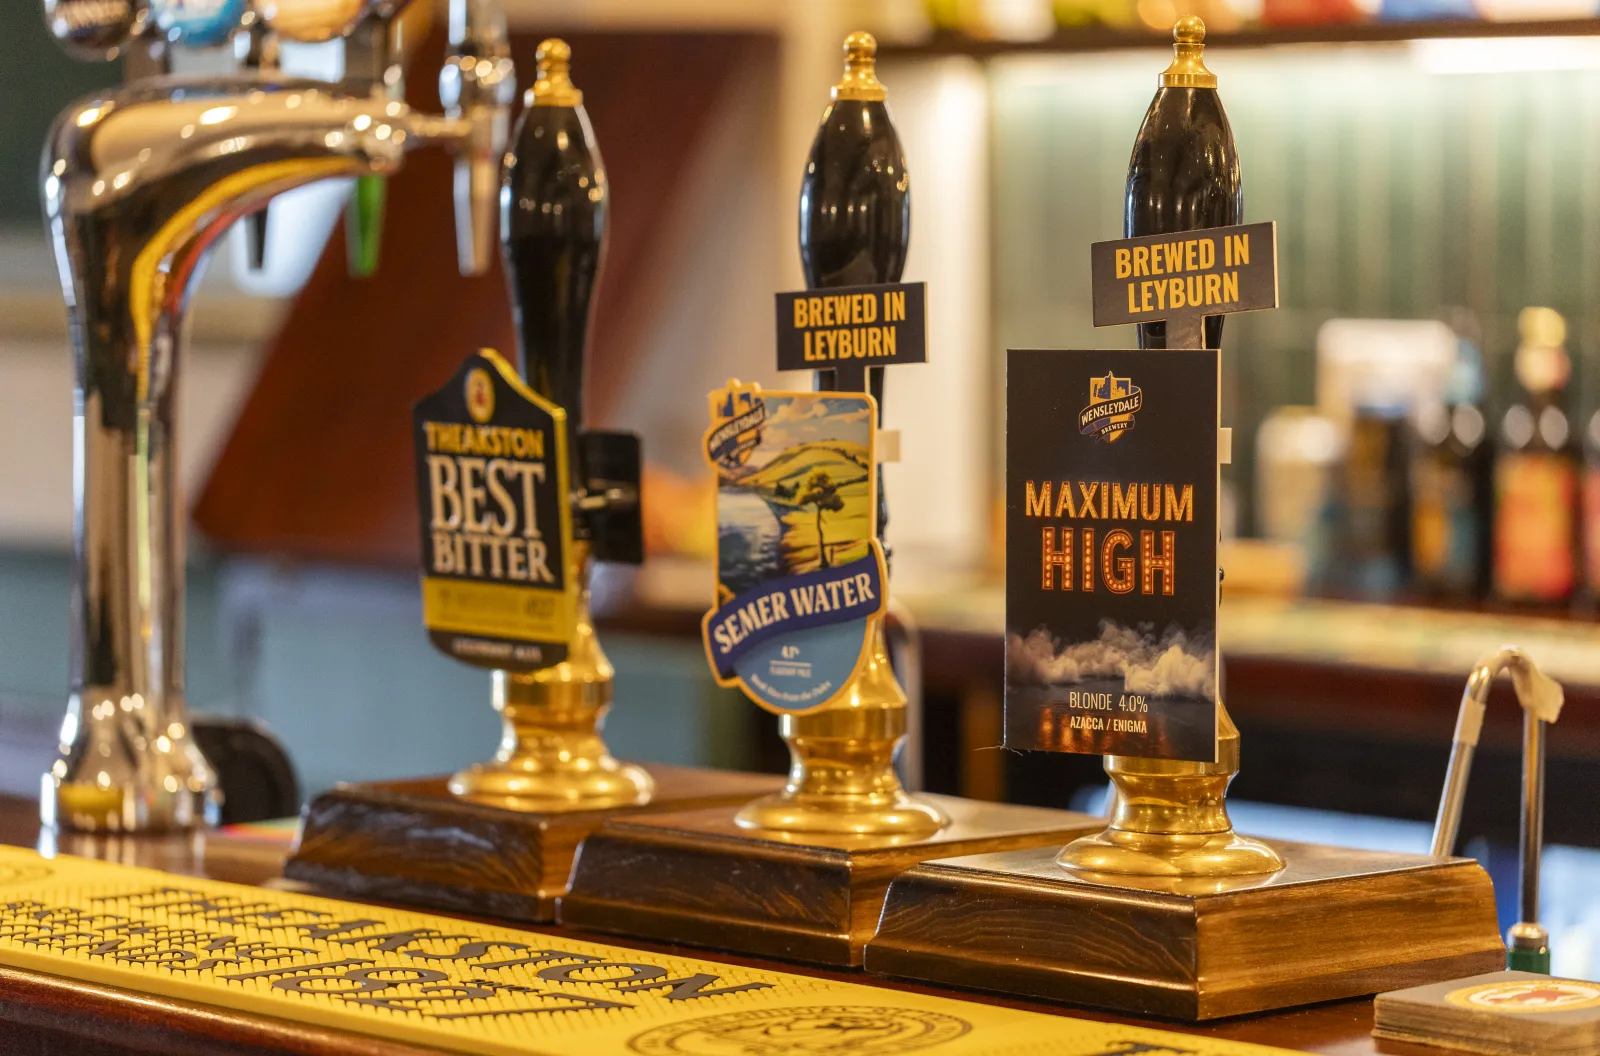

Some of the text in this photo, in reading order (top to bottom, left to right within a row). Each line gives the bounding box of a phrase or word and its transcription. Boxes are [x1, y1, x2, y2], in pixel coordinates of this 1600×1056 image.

[1115, 234, 1249, 279] BREWED IN
[794, 291, 906, 328] BREWED IN
[1128, 271, 1239, 314] LEYBURN
[804, 326, 896, 361] LEYBURN
[1081, 396, 1139, 426] WENSLEYDALE
[1101, 422, 1128, 435] BREWERY
[423, 421, 545, 459] THEAKSTON
[426, 454, 547, 539] BEST
[1025, 480, 1193, 522] MAXIMUM
[432, 529, 555, 583] BITTER
[1041, 526, 1175, 596] HIGH
[713, 572, 875, 654] SEMER WATER
[1069, 691, 1148, 713] BLONDE 4.0%
[1070, 716, 1104, 731] AZACCA
[1113, 719, 1147, 734] ENIGMA
[89, 886, 776, 1001] THEAKSTON
[216, 957, 637, 1019] 1827
